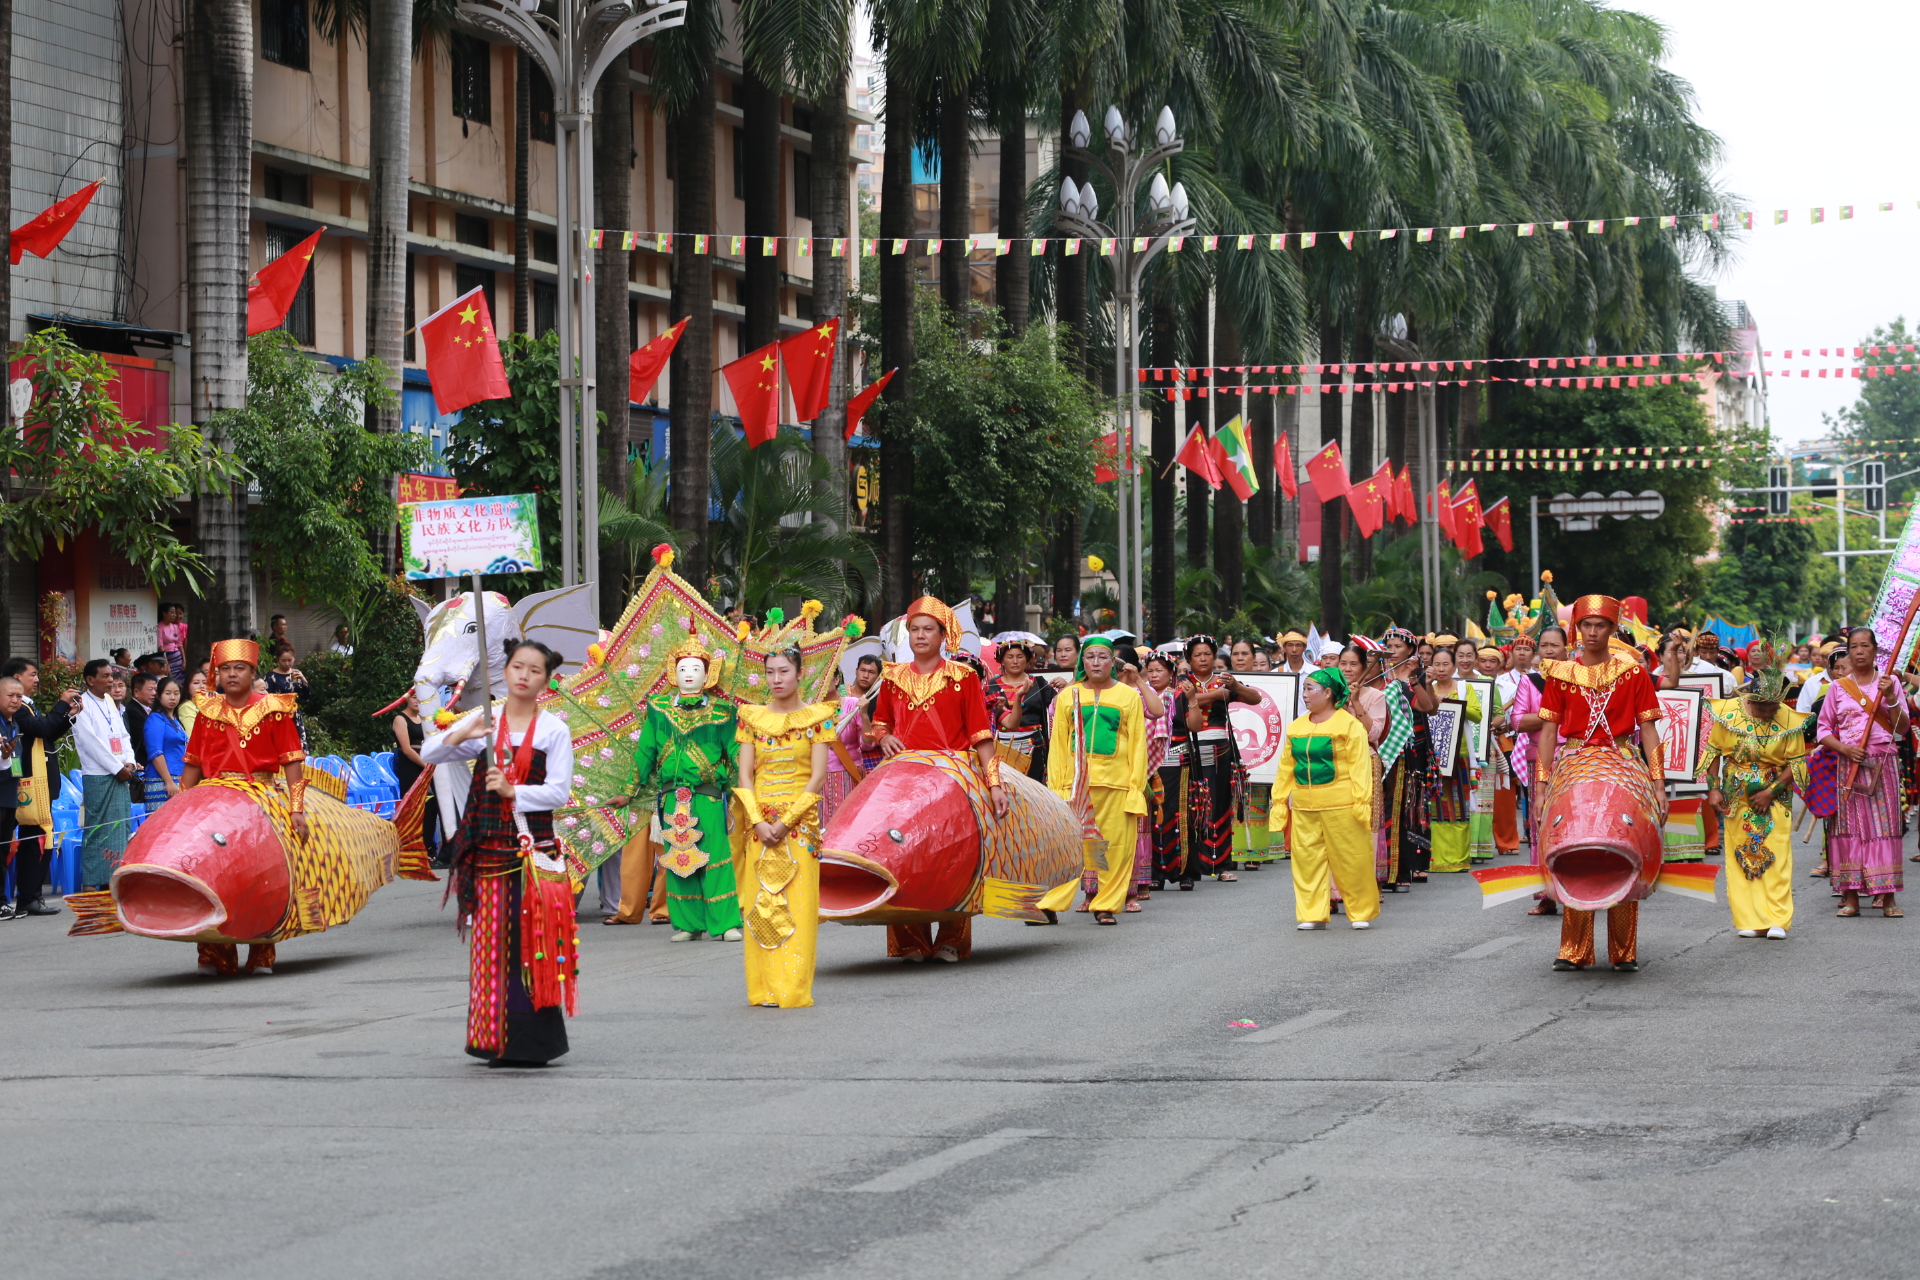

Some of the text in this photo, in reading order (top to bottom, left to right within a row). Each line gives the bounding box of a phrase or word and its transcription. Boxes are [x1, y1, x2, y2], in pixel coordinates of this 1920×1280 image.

[413, 502, 519, 522] 非物质文化遗产
[421, 517, 513, 537] 民族文化方队
[109, 604, 137, 619] 联系电话
